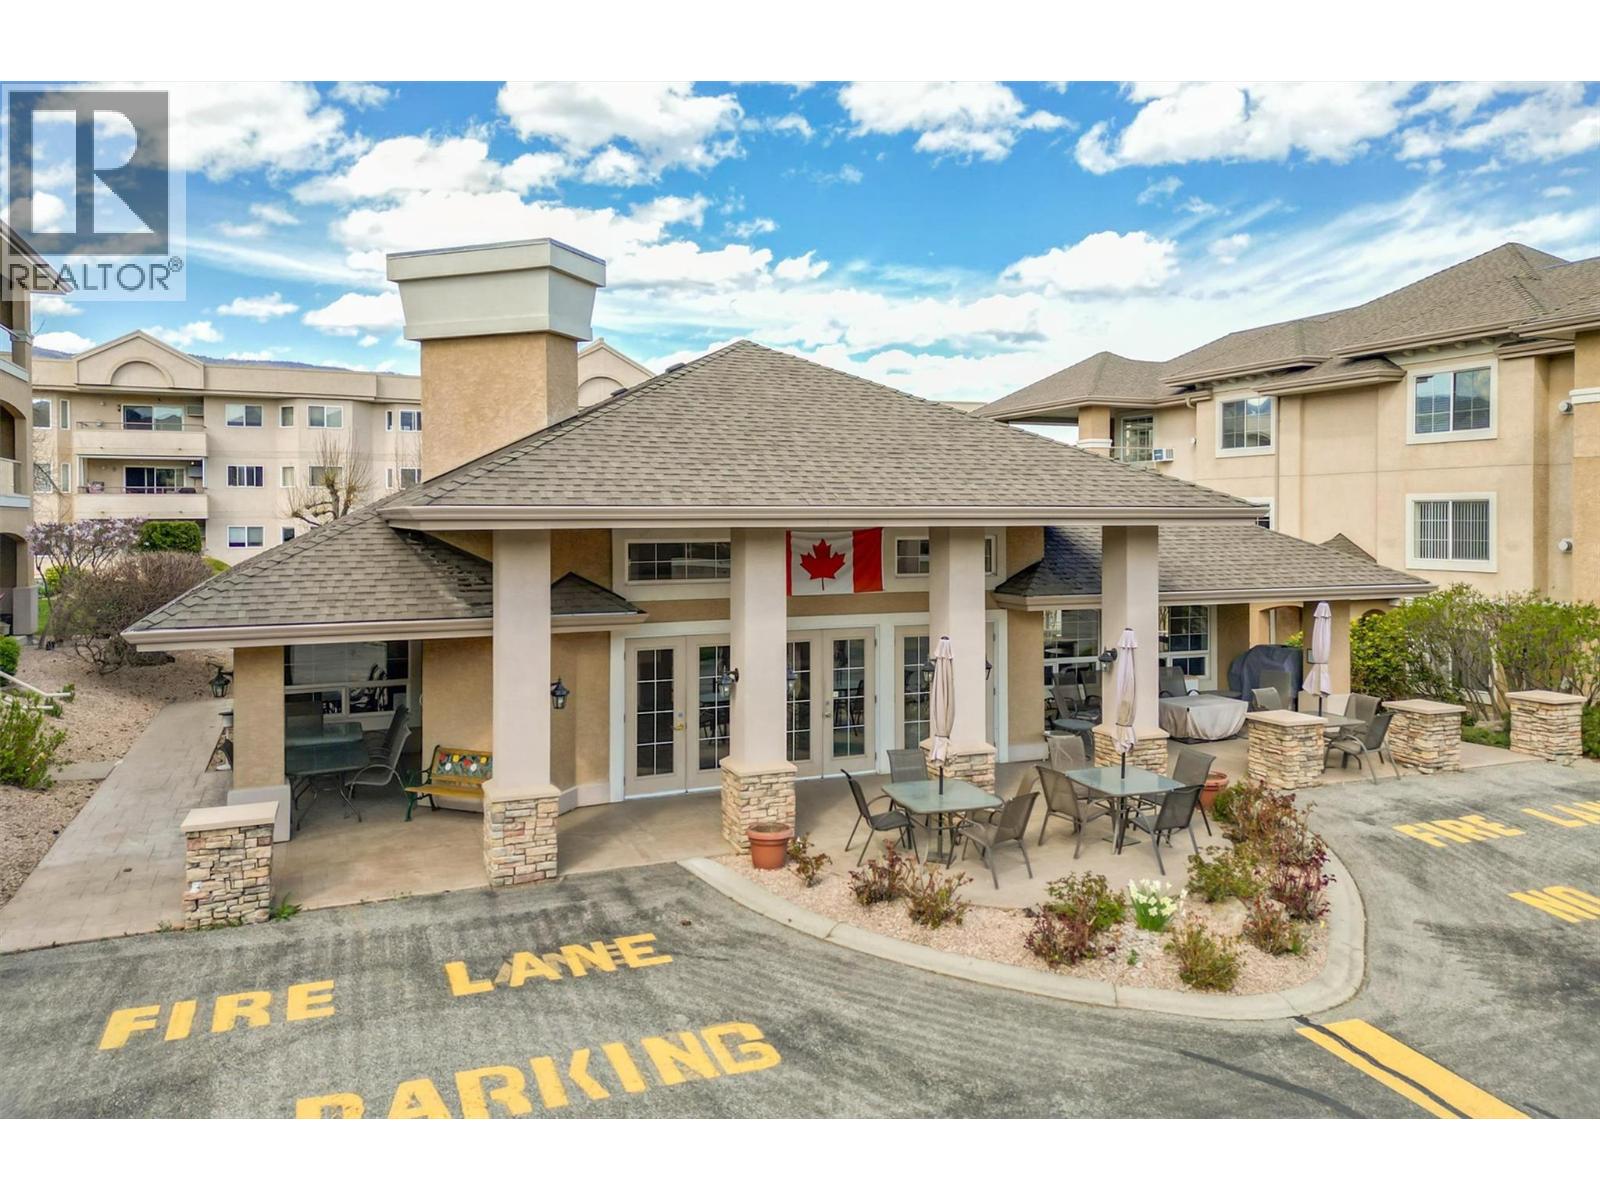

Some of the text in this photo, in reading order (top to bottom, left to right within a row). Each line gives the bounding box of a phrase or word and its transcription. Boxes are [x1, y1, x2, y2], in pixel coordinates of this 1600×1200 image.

[1392, 814, 1526, 848] FIRE
[99, 932, 673, 1050] FIRE LANE
